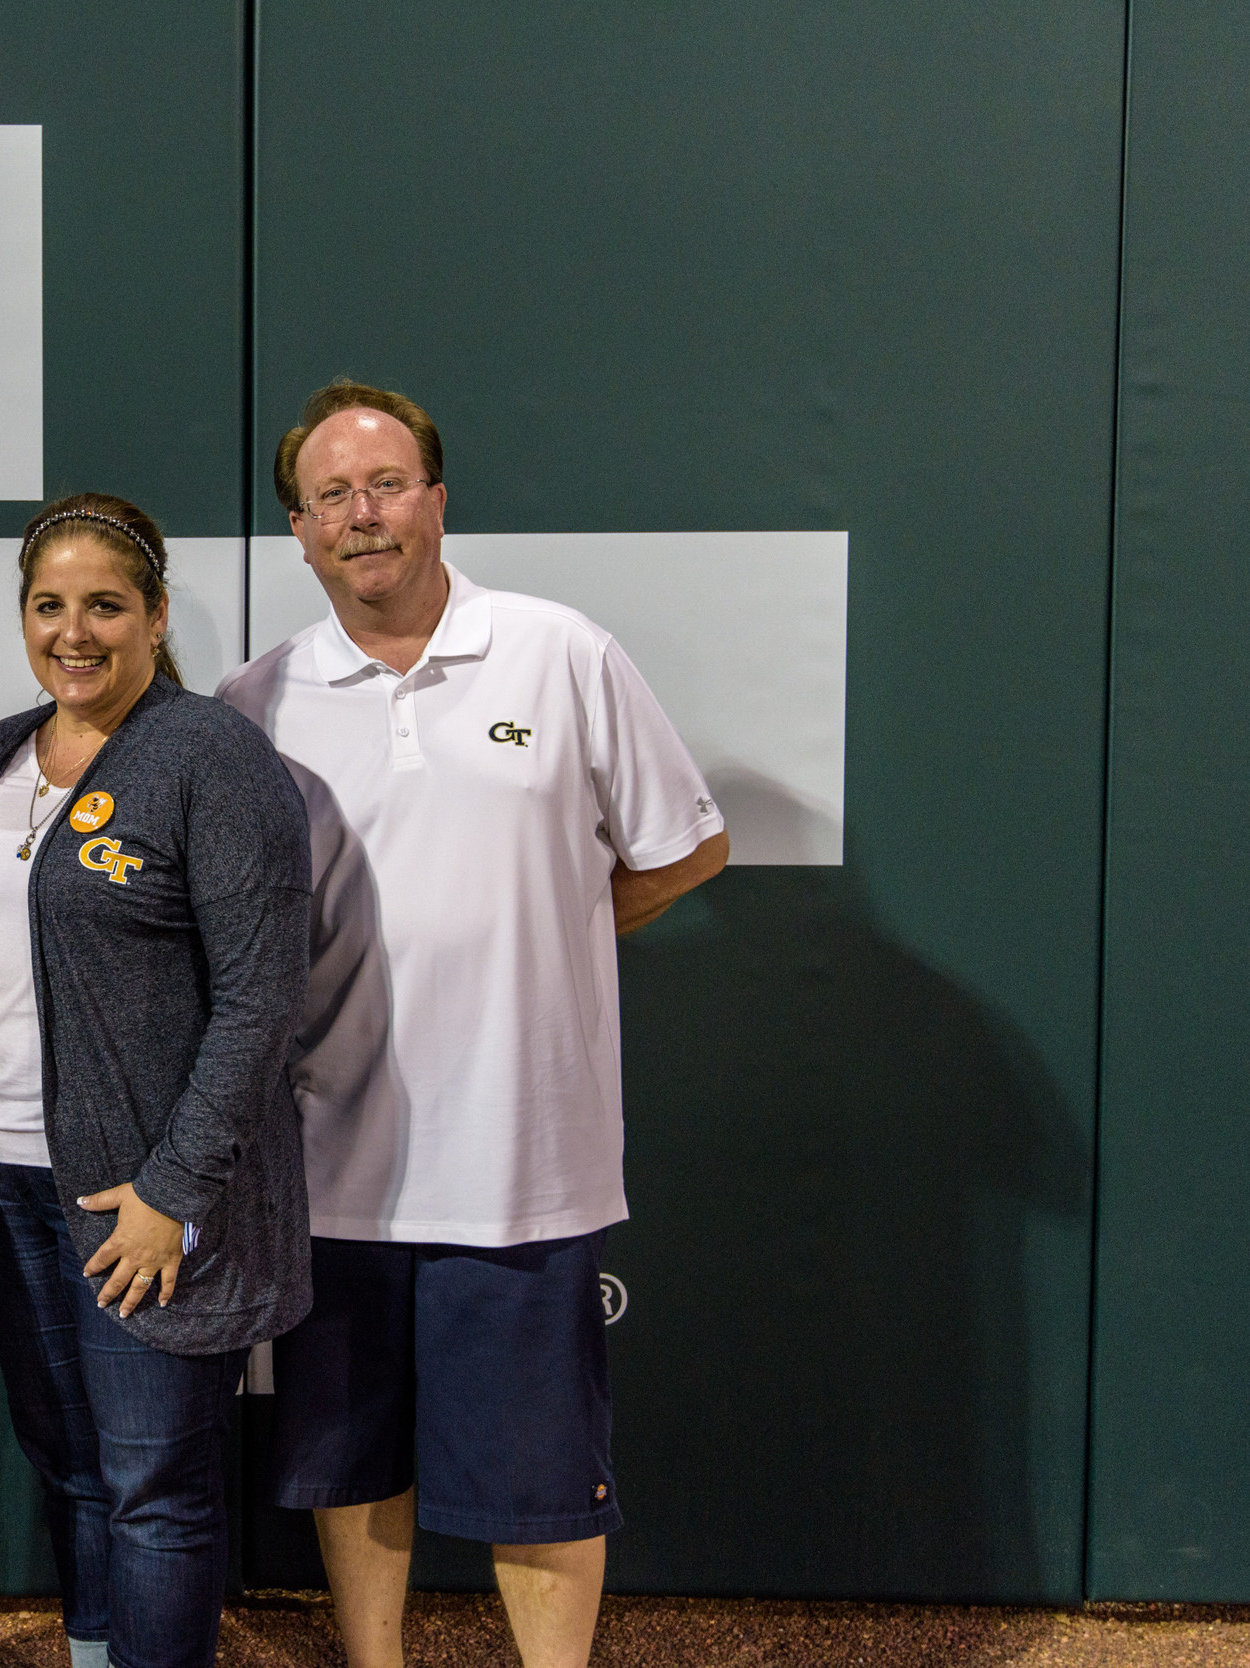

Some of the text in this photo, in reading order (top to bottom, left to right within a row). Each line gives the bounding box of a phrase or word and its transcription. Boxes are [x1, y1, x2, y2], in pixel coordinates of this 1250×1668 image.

[488, 721, 531, 746] GT
[73, 810, 100, 826] MOM
[78, 836, 144, 885] GT
